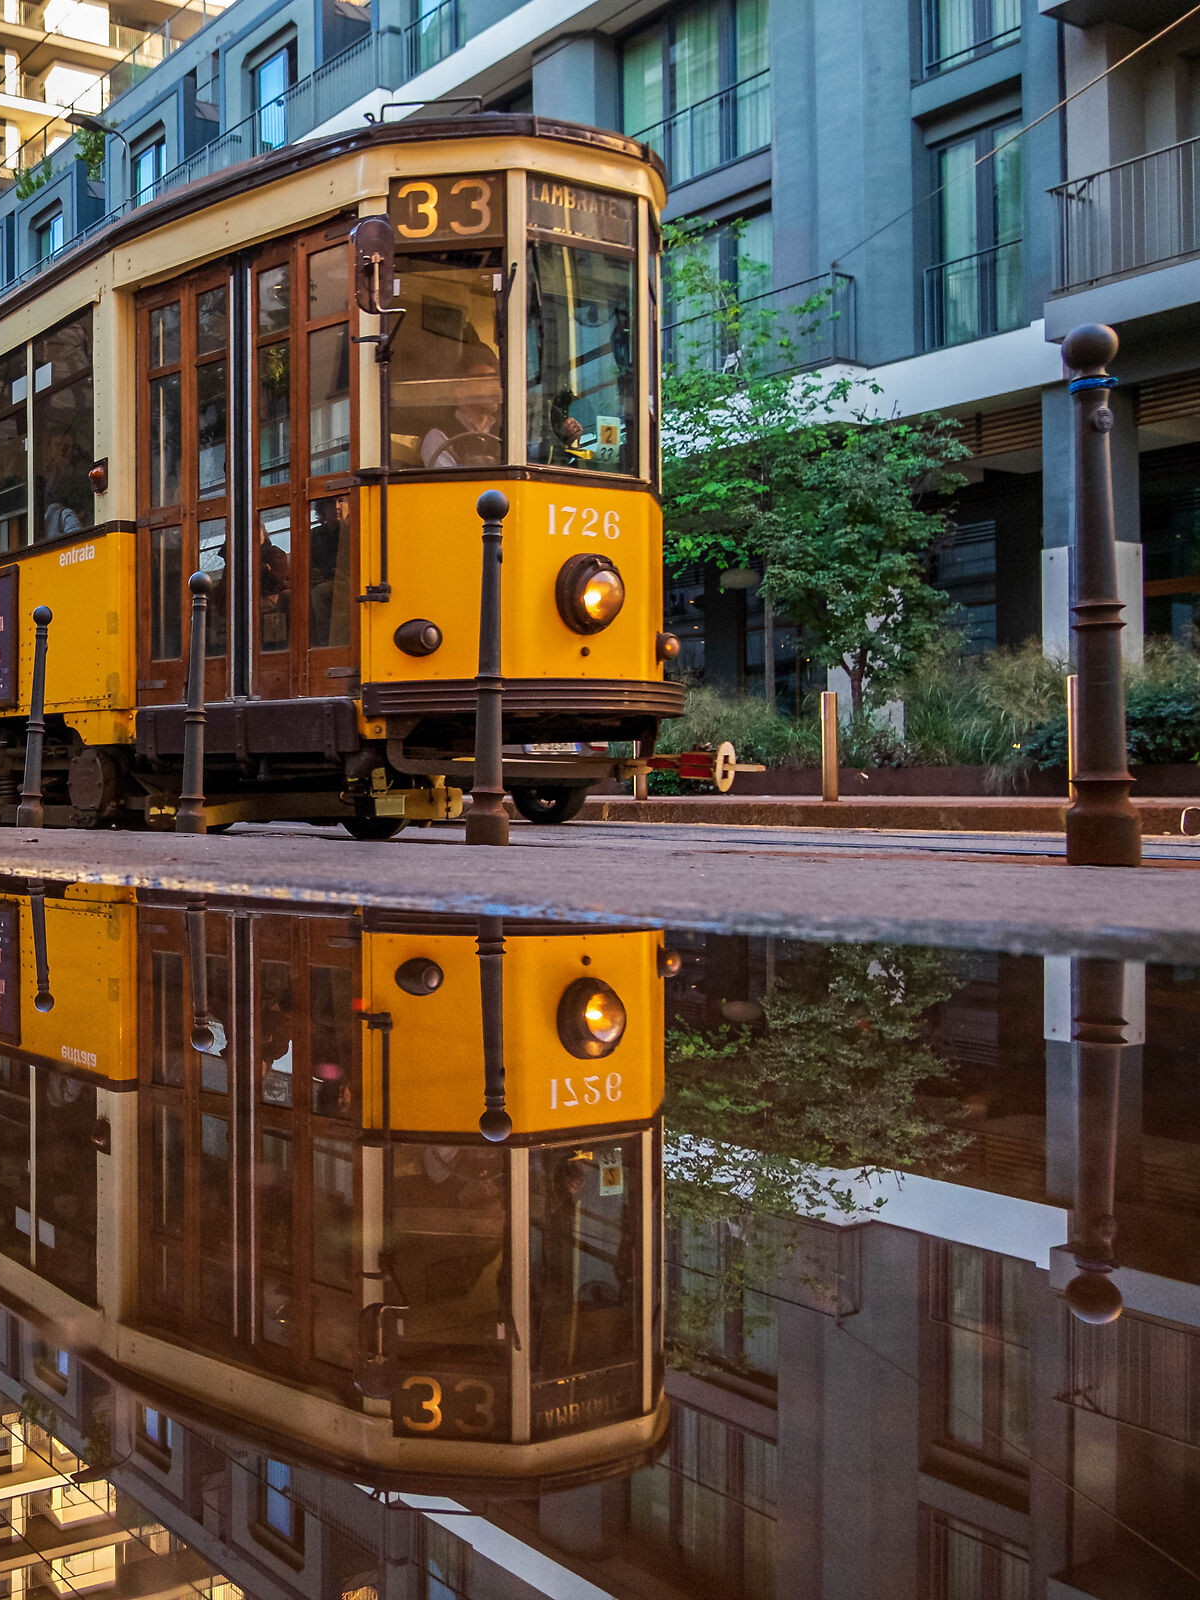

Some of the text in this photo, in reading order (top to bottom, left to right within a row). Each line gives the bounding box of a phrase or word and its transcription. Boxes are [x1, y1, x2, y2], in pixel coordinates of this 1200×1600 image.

[397, 179, 491, 239] 33
[531, 181, 617, 219] LAMBRATE
[548, 503, 621, 540] 1726
[59, 544, 95, 567] entrata
